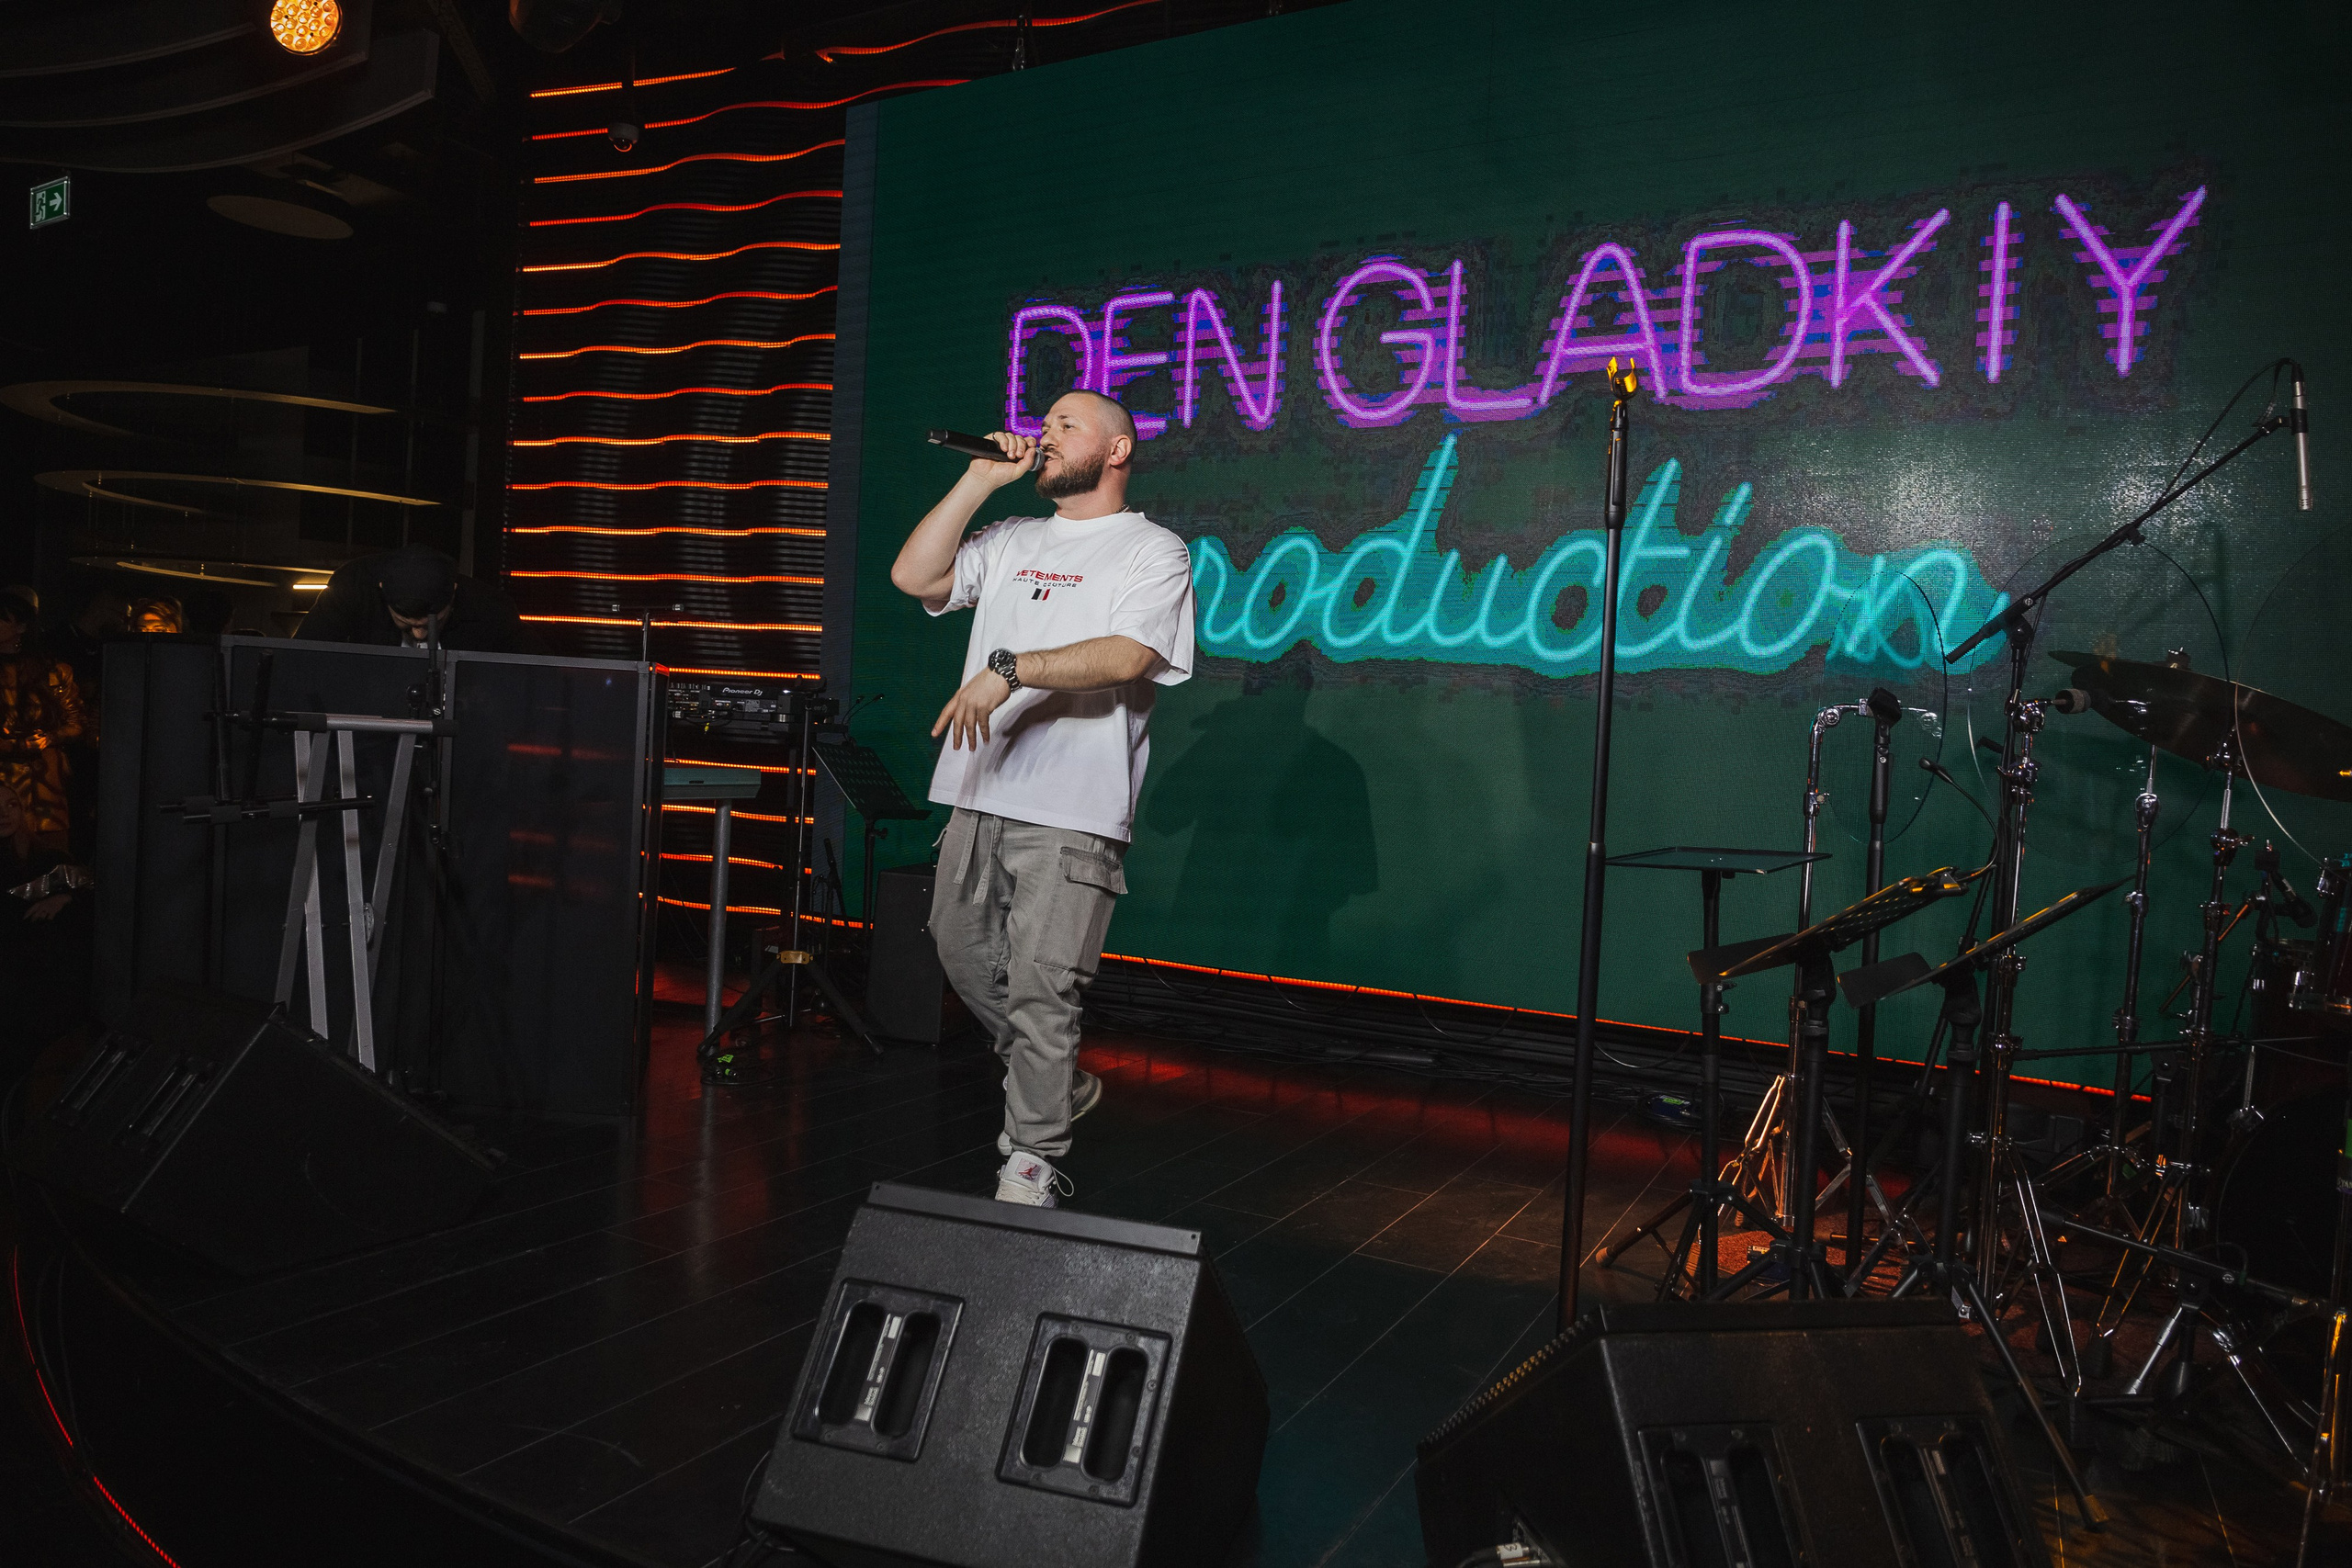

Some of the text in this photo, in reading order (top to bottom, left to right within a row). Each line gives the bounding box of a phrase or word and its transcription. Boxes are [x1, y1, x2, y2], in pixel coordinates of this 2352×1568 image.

[1007, 278, 1284, 438] DEN
[1016, 570, 1084, 583] VETEMENTS
[1193, 432, 2010, 661] roduction
